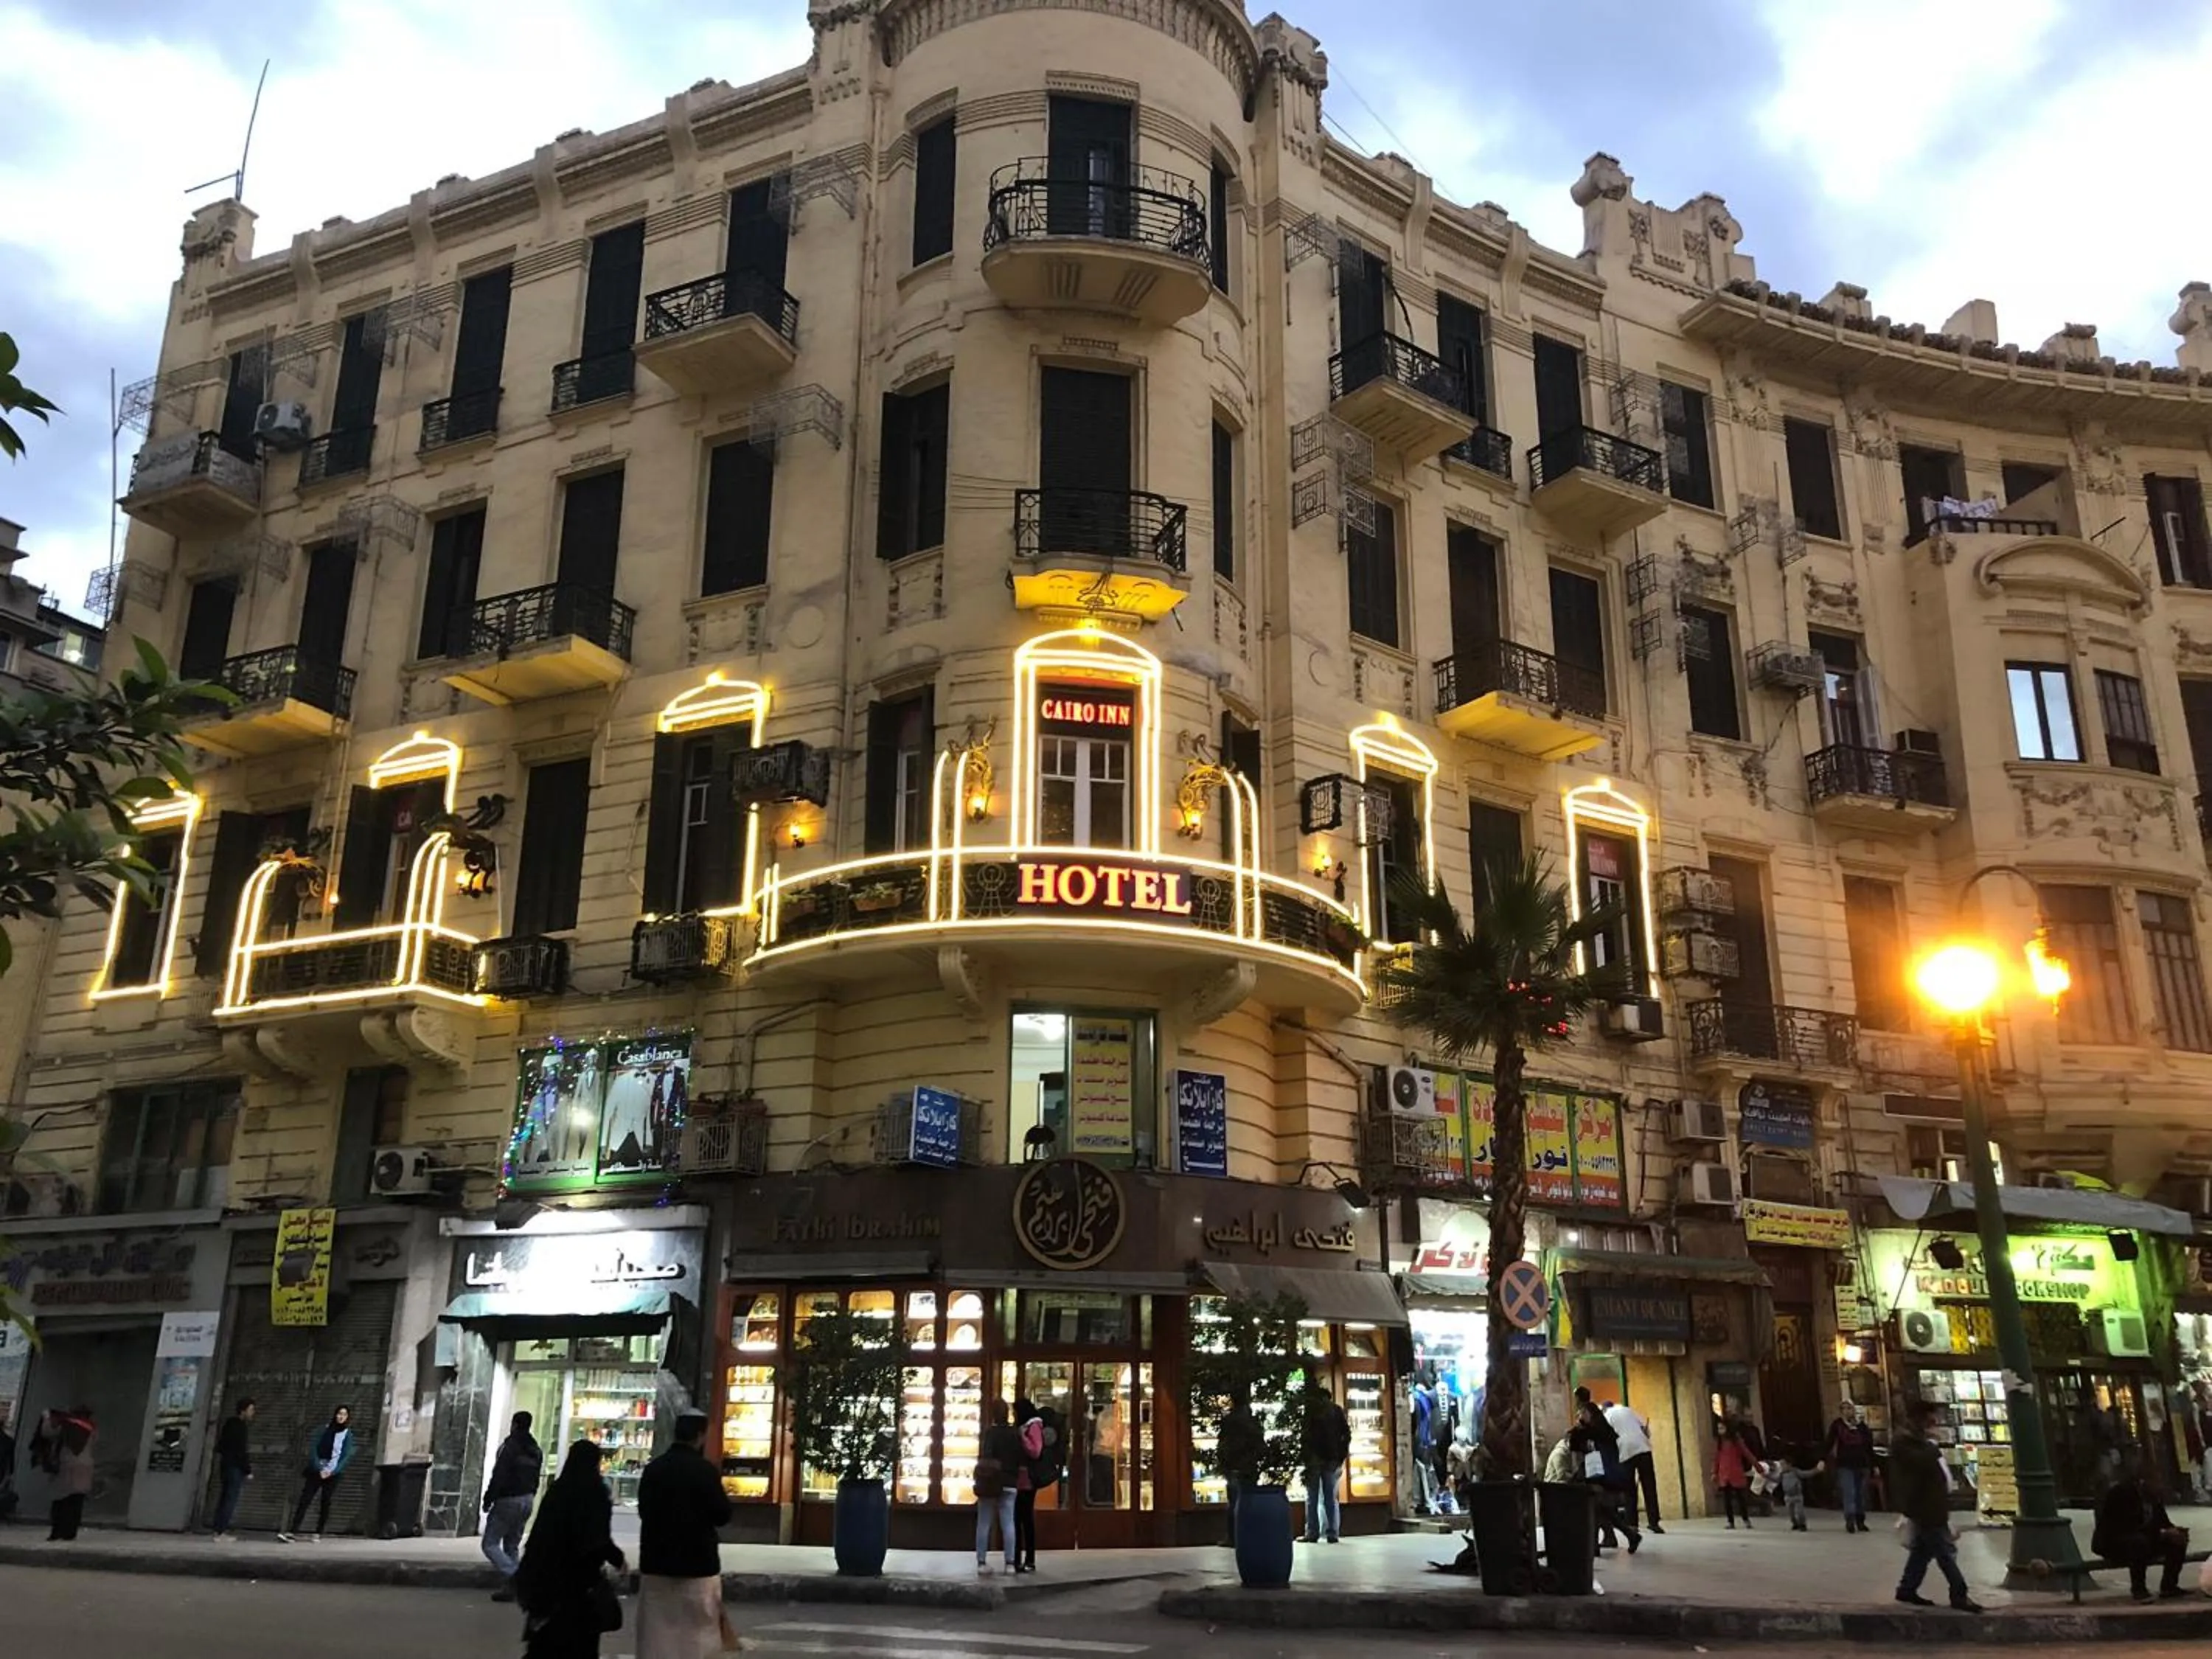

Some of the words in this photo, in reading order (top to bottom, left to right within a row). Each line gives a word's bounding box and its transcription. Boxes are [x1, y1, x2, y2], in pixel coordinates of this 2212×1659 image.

[1041, 698, 1095, 724] CAIRO
[1098, 703, 1131, 726] INN
[1017, 863, 1192, 915] HOTEL
[617, 1046, 683, 1066] Casablanca
[1577, 1099, 1613, 1144] مركز
[1531, 1144, 1569, 1171] نور
[2016, 1279, 2090, 1300] OOKSHOP
